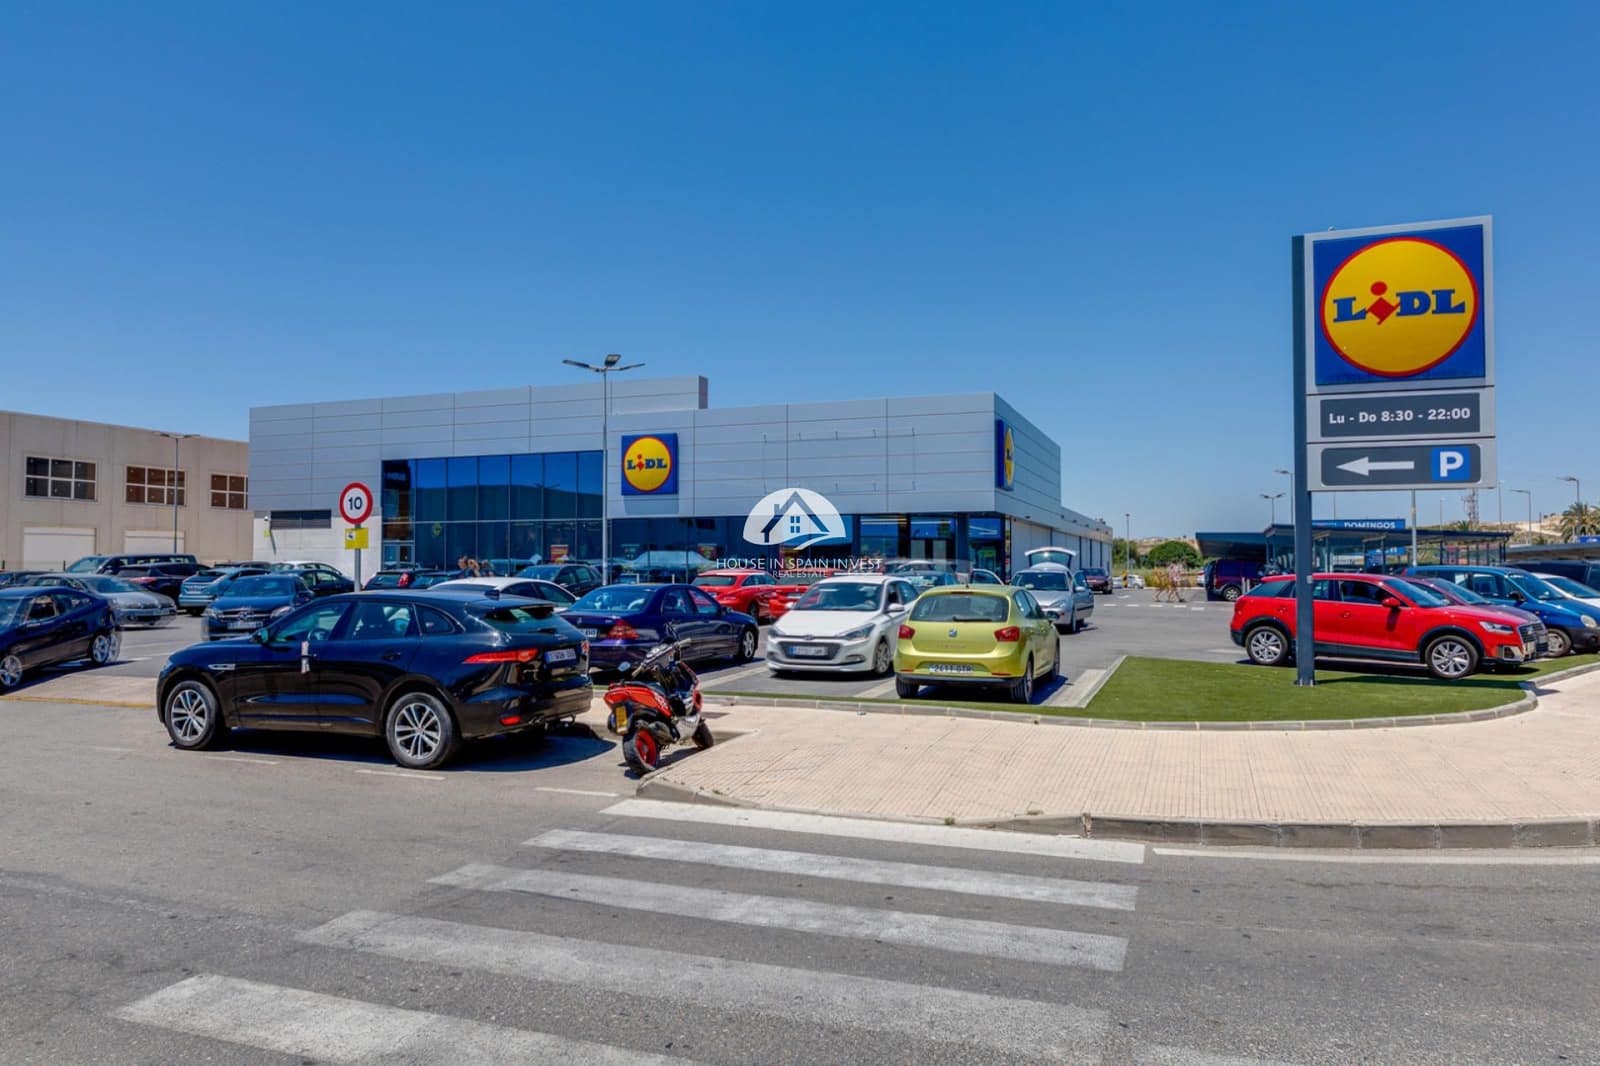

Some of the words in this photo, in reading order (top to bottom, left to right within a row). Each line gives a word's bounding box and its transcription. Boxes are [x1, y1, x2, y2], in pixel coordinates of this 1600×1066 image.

[1329, 412, 1345, 424] Lu
[1359, 411, 1377, 423] Do
[1380, 410, 1414, 422] 8:30
[1427, 407, 1471, 420] 22:00
[1439, 451, 1464, 477] P
[348, 496, 363, 510] 10
